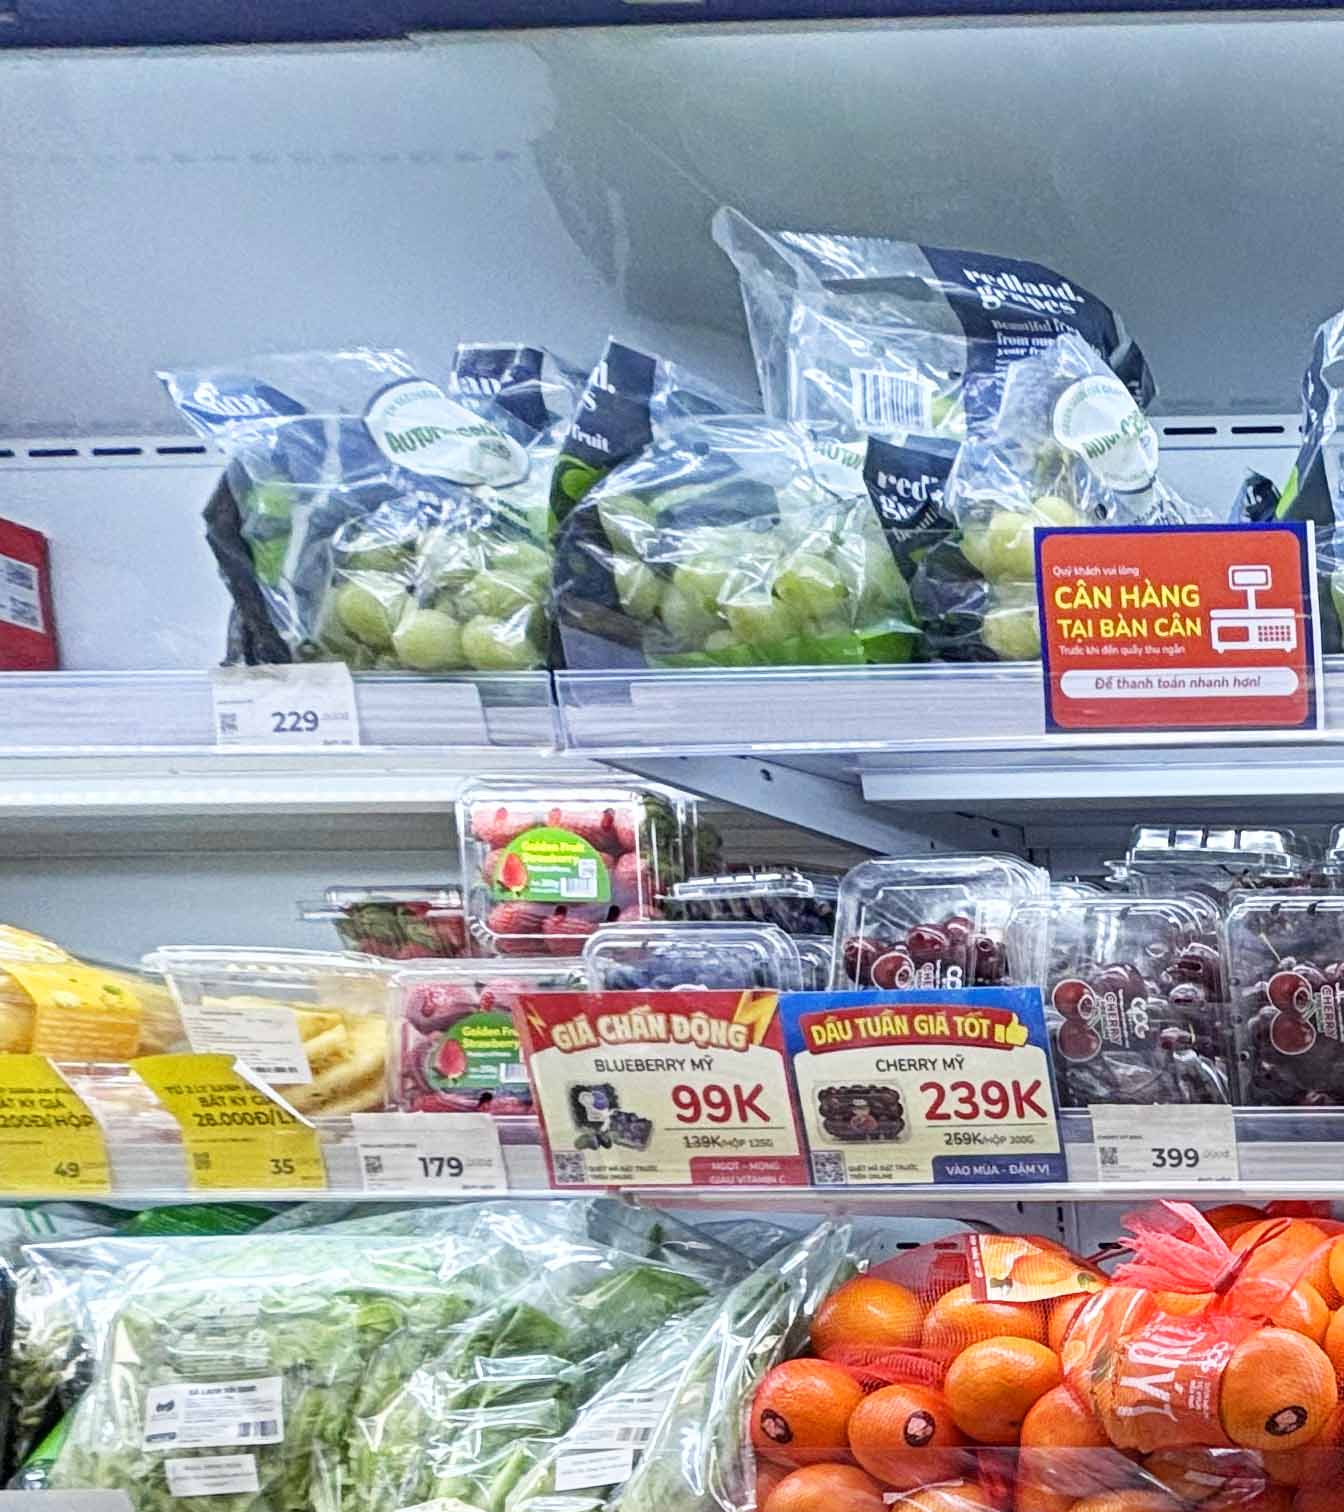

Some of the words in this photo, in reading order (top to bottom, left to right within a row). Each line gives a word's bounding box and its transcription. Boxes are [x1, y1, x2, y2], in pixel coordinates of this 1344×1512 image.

[1054, 579, 1112, 610] CÂN
[1120, 578, 1201, 608] HÀNG
[1057, 618, 1093, 643] TẠI
[1100, 613, 1147, 638] BÀN
[1153, 612, 1202, 638] CÂN
[1116, 677, 1153, 691] thanh
[1189, 675, 1230, 689] nhanh
[271, 710, 320, 734] 229
[552, 1015, 598, 1050] GIÁ
[599, 1005, 668, 1044] CHẤN
[670, 1013, 749, 1050] ĐỘNG
[913, 1010, 950, 1037] GIÁ
[954, 1011, 992, 1039] TỐT
[594, 1058, 686, 1073] BLUEBERRY
[690, 1055, 715, 1072] MỸ
[875, 1058, 938, 1073] CHERRY
[943, 1054, 966, 1071] MỸ
[671, 1083, 771, 1124] 99K
[919, 1080, 1048, 1121] 239K
[269, 1159, 296, 1175] 35
[418, 1155, 465, 1178] 179
[1150, 1146, 1200, 1168] 399
[53, 1160, 81, 1178] 49
